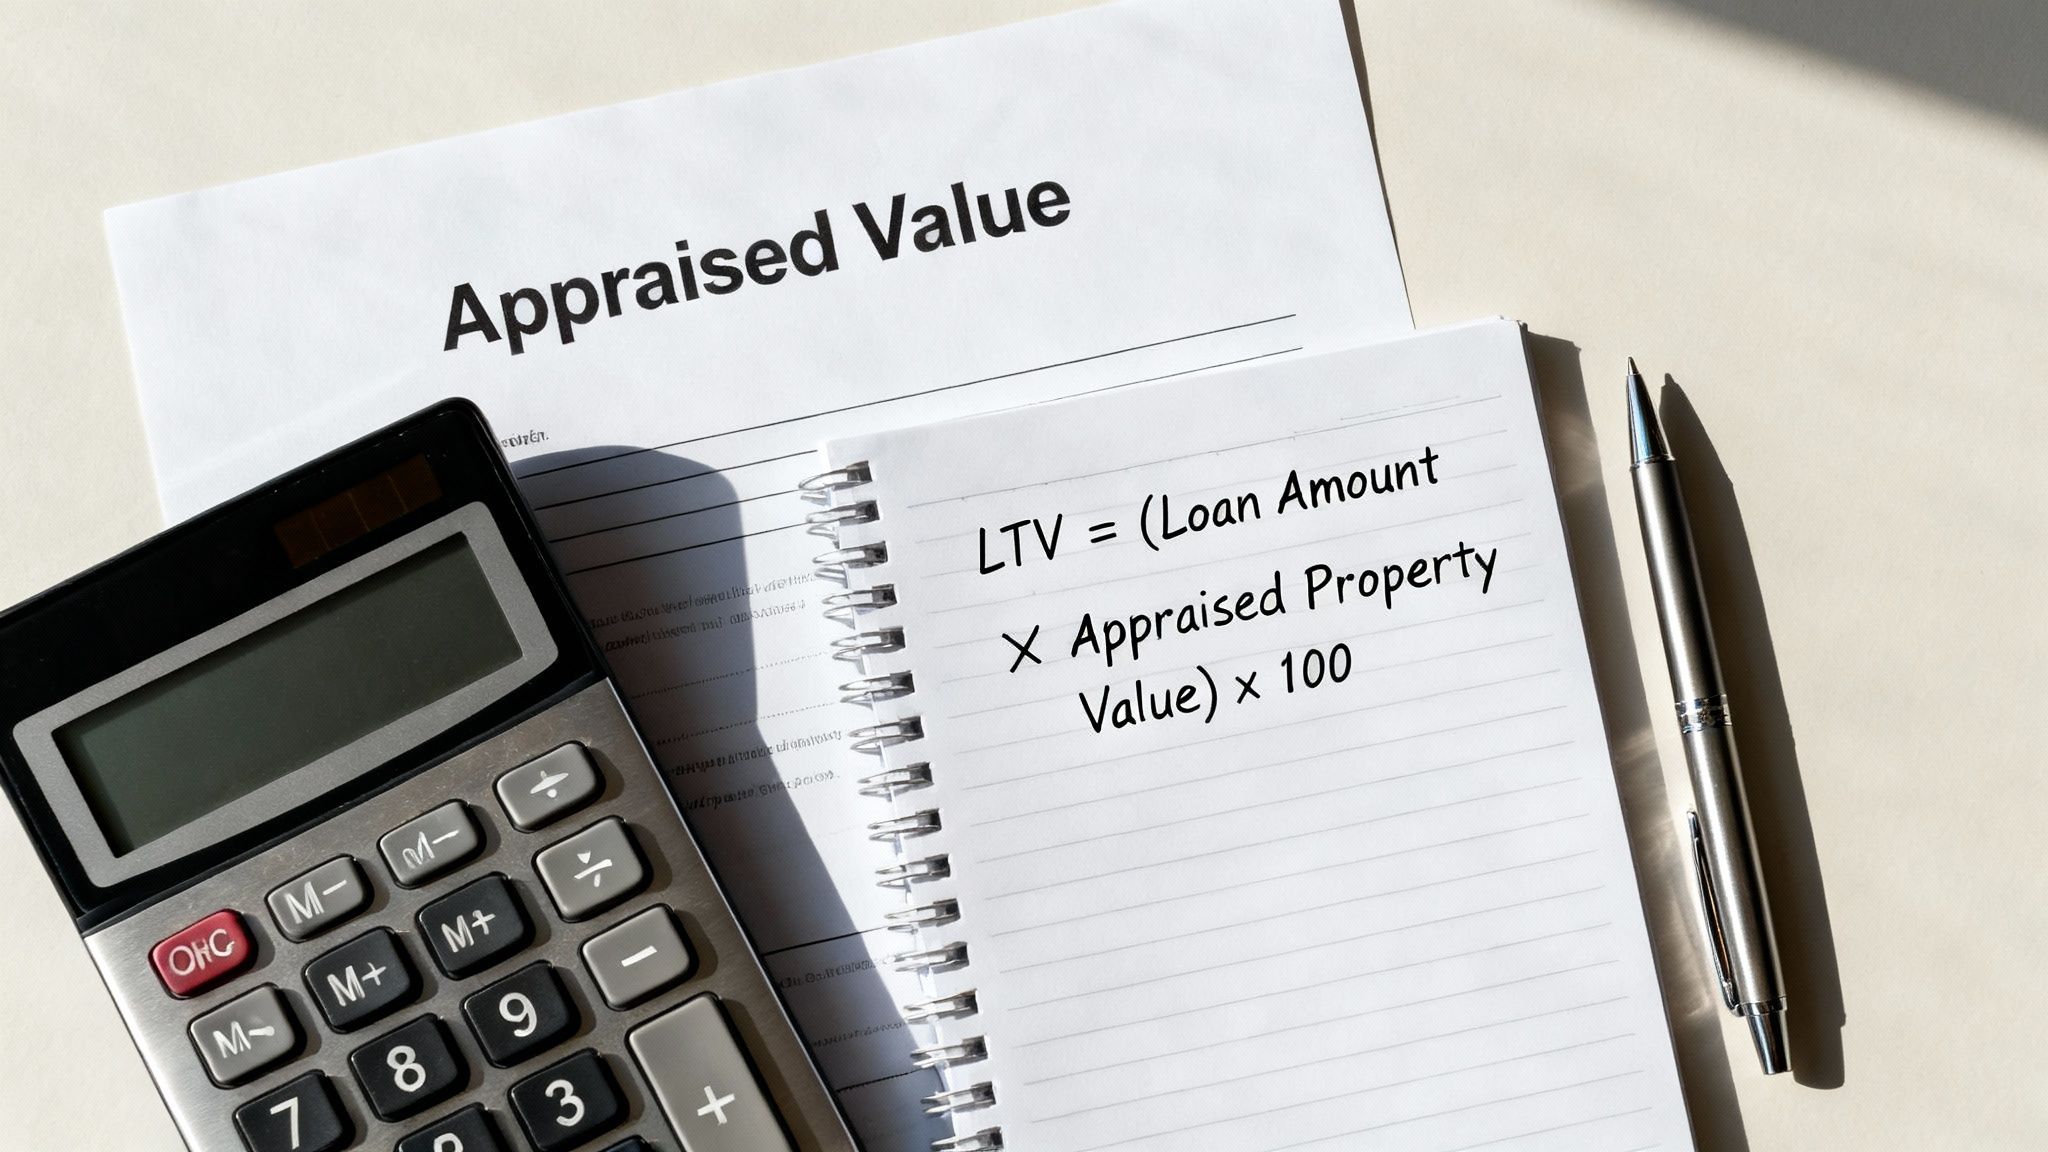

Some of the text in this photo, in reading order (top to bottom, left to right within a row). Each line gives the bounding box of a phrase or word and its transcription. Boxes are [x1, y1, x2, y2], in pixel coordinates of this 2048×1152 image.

[444, 182, 1070, 355] Appraised Value
[979, 513, 1063, 575] LTV
[1140, 493, 1261, 552] (Loan
[1277, 446, 1439, 515] Amount
[1070, 570, 1286, 668] Appraised
[1304, 541, 1498, 610] Property
[1079, 665, 1218, 734] Value)
[1281, 642, 1352, 694] 100
[440, 909, 496, 953] M+
[326, 962, 387, 1007] M+
[499, 991, 538, 1038] 9
[386, 1044, 427, 1093] 8
[269, 1095, 300, 1151] 7
[545, 1079, 586, 1127] 3
